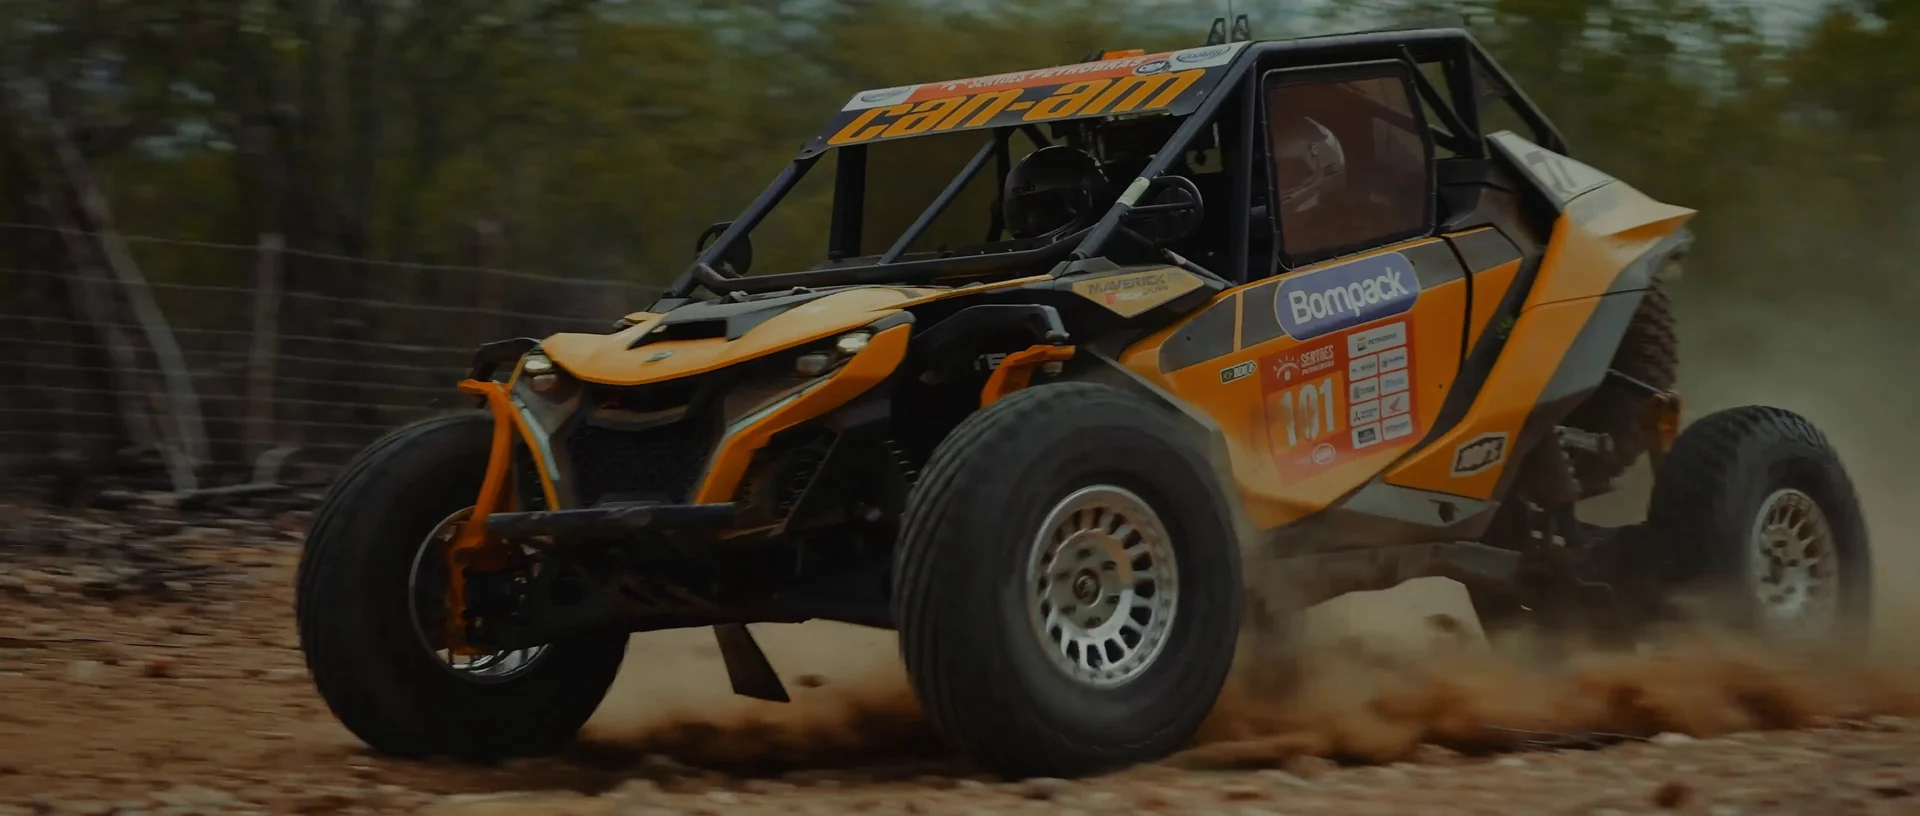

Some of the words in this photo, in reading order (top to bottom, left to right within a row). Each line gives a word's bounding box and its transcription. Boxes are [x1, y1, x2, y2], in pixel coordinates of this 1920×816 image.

[827, 68, 1207, 145] can-am
[1288, 266, 1409, 326] Bompack
[1279, 376, 1336, 446] 101
